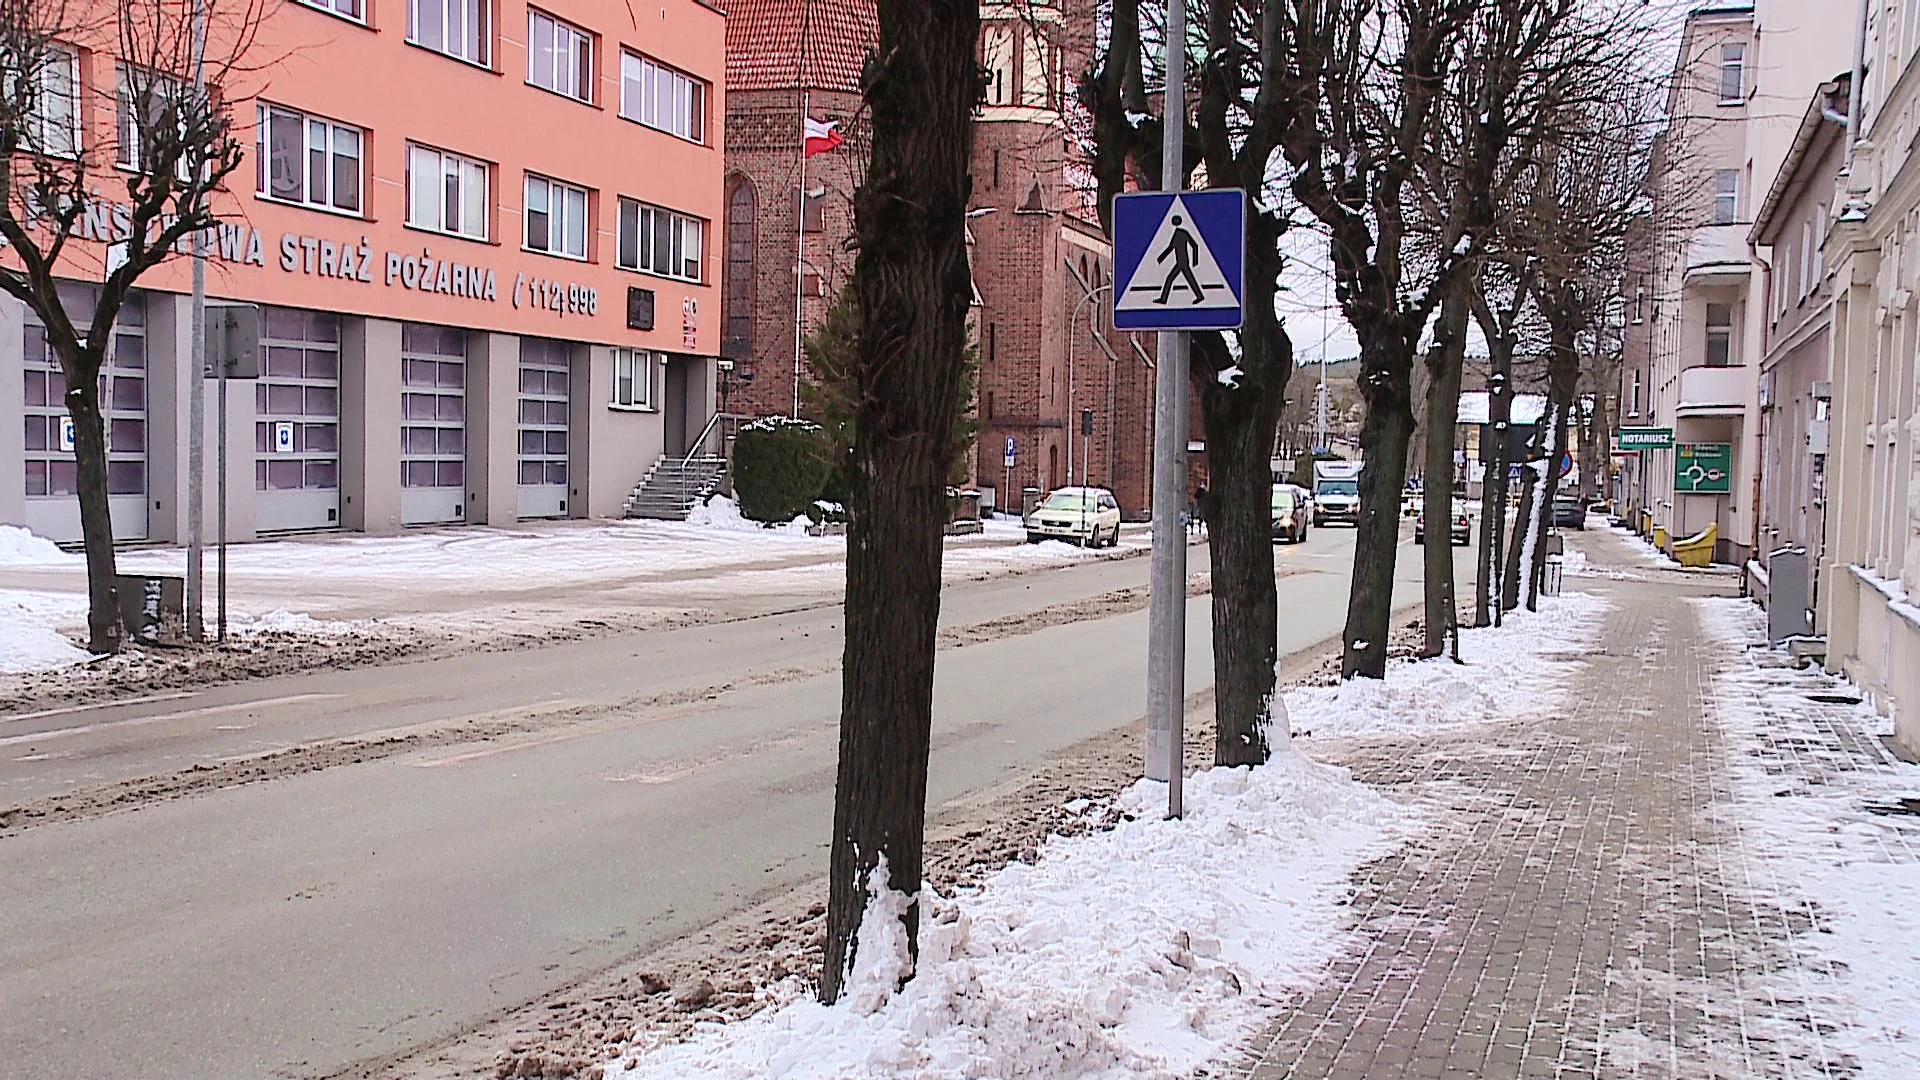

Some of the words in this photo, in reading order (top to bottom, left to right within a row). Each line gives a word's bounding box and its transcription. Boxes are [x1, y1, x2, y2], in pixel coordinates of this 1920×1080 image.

[279, 231, 373, 283] STRAŻ
[385, 247, 497, 301] POŻARNA
[1621, 433, 1670, 444] NOTARIUSZ
